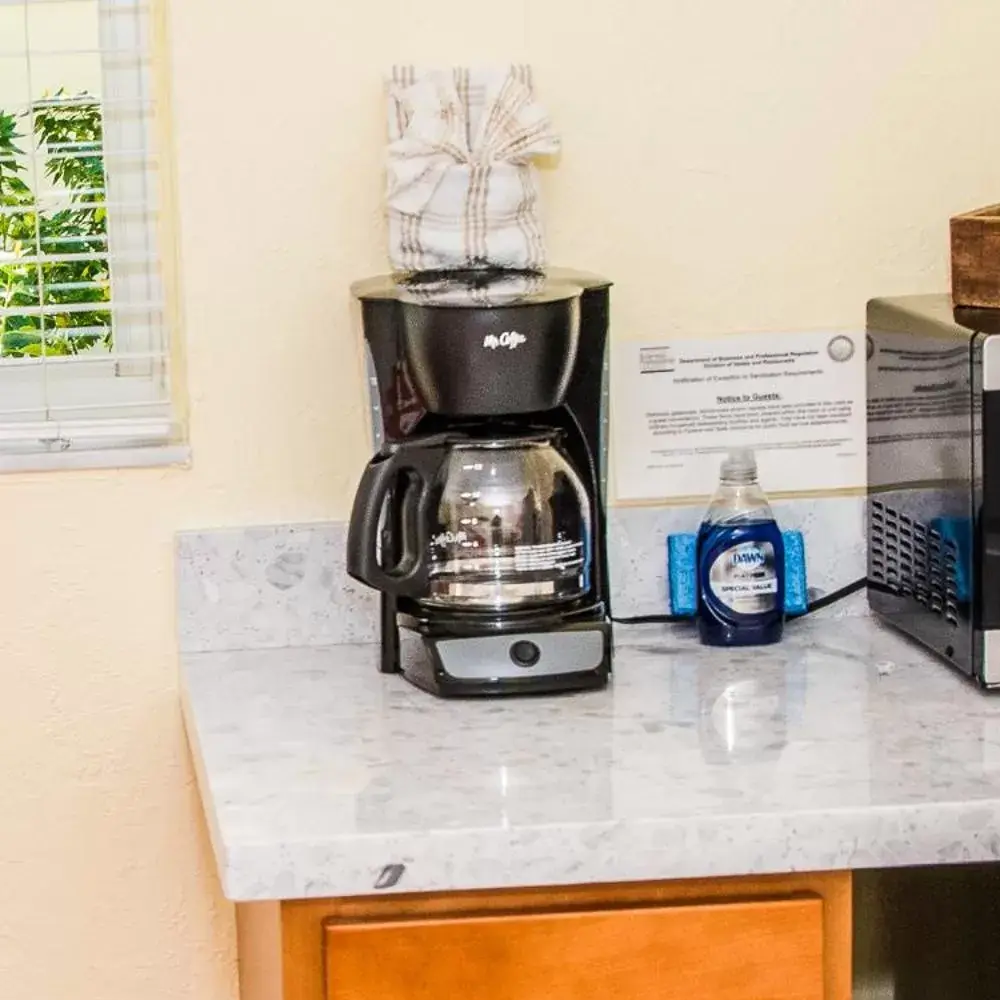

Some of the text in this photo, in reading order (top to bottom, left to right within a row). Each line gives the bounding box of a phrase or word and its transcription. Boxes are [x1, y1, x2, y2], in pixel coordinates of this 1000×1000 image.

[716, 394, 741, 404] Notice
[742, 393, 750, 402] to
[732, 552, 764, 564] DAWN
[722, 584, 749, 593] SPECIAL
